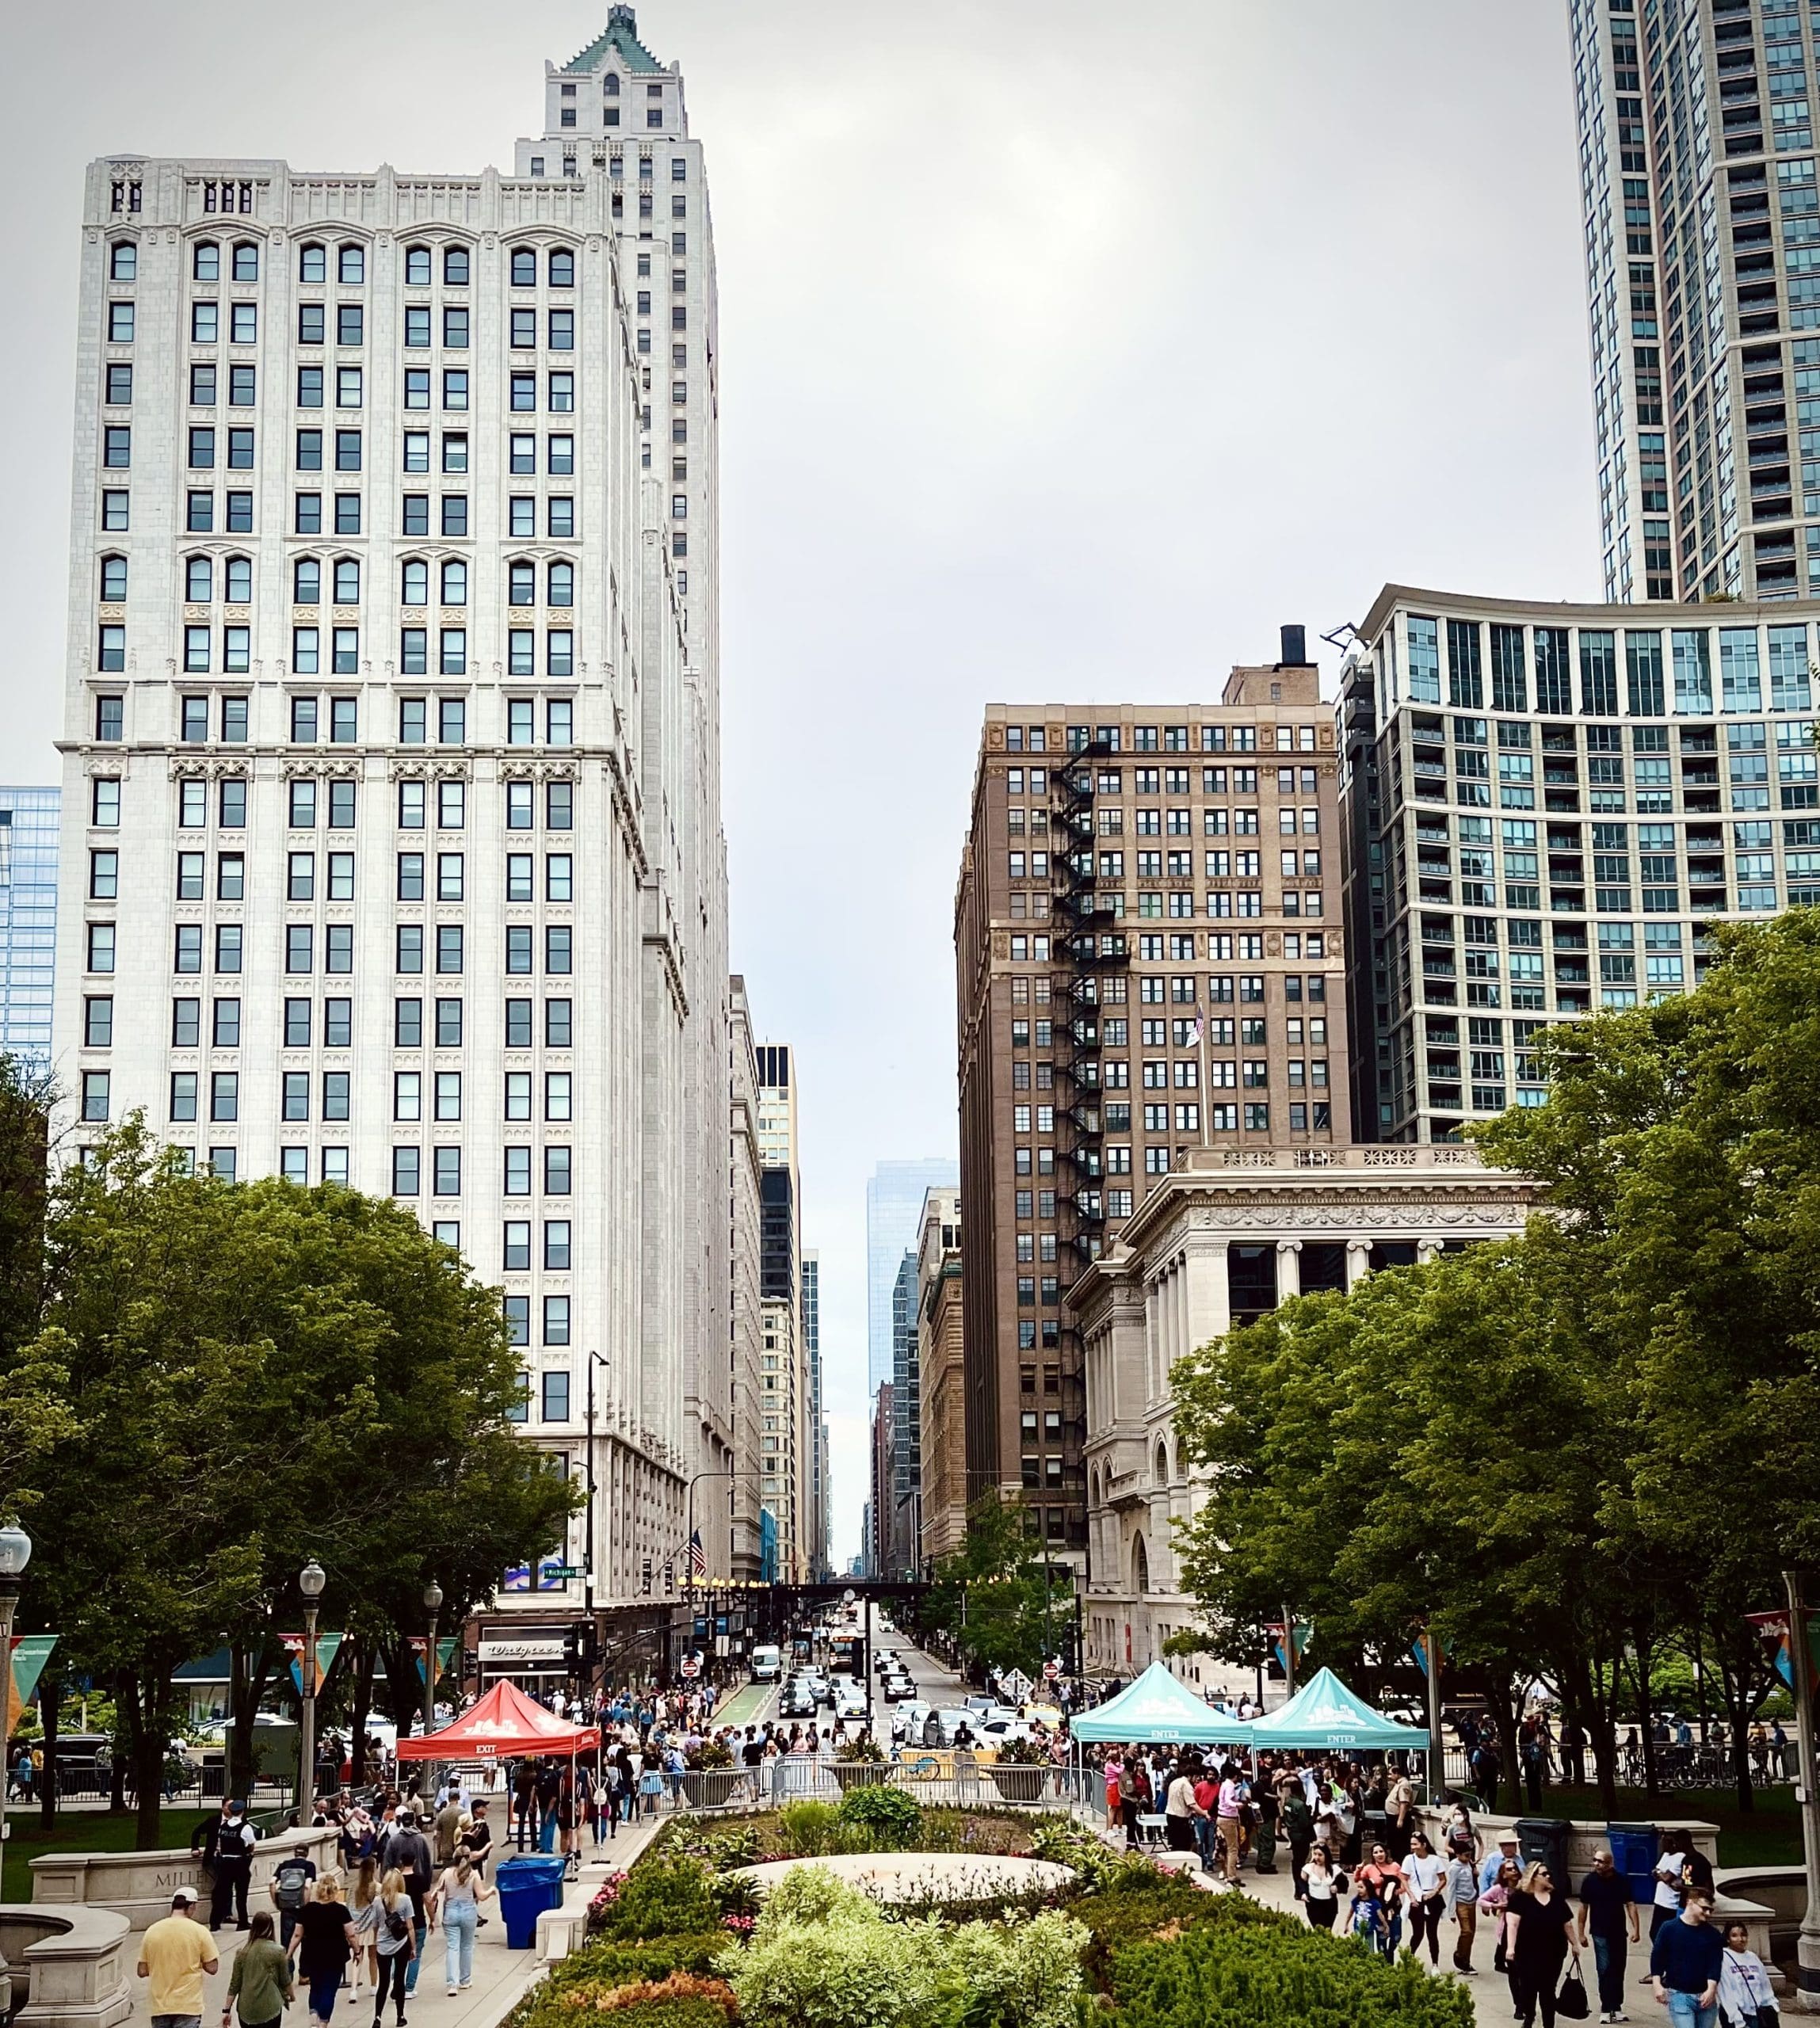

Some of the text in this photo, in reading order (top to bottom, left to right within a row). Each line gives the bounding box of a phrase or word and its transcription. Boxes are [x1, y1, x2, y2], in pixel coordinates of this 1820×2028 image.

[489, 1646, 564, 1659] Walgreen
[1151, 1729, 1179, 1739] ENTER
[475, 1744, 496, 1754] EXIT
[1568, 1843, 1599, 1857] ARK
[155, 1870, 216, 1887] MILLEN
